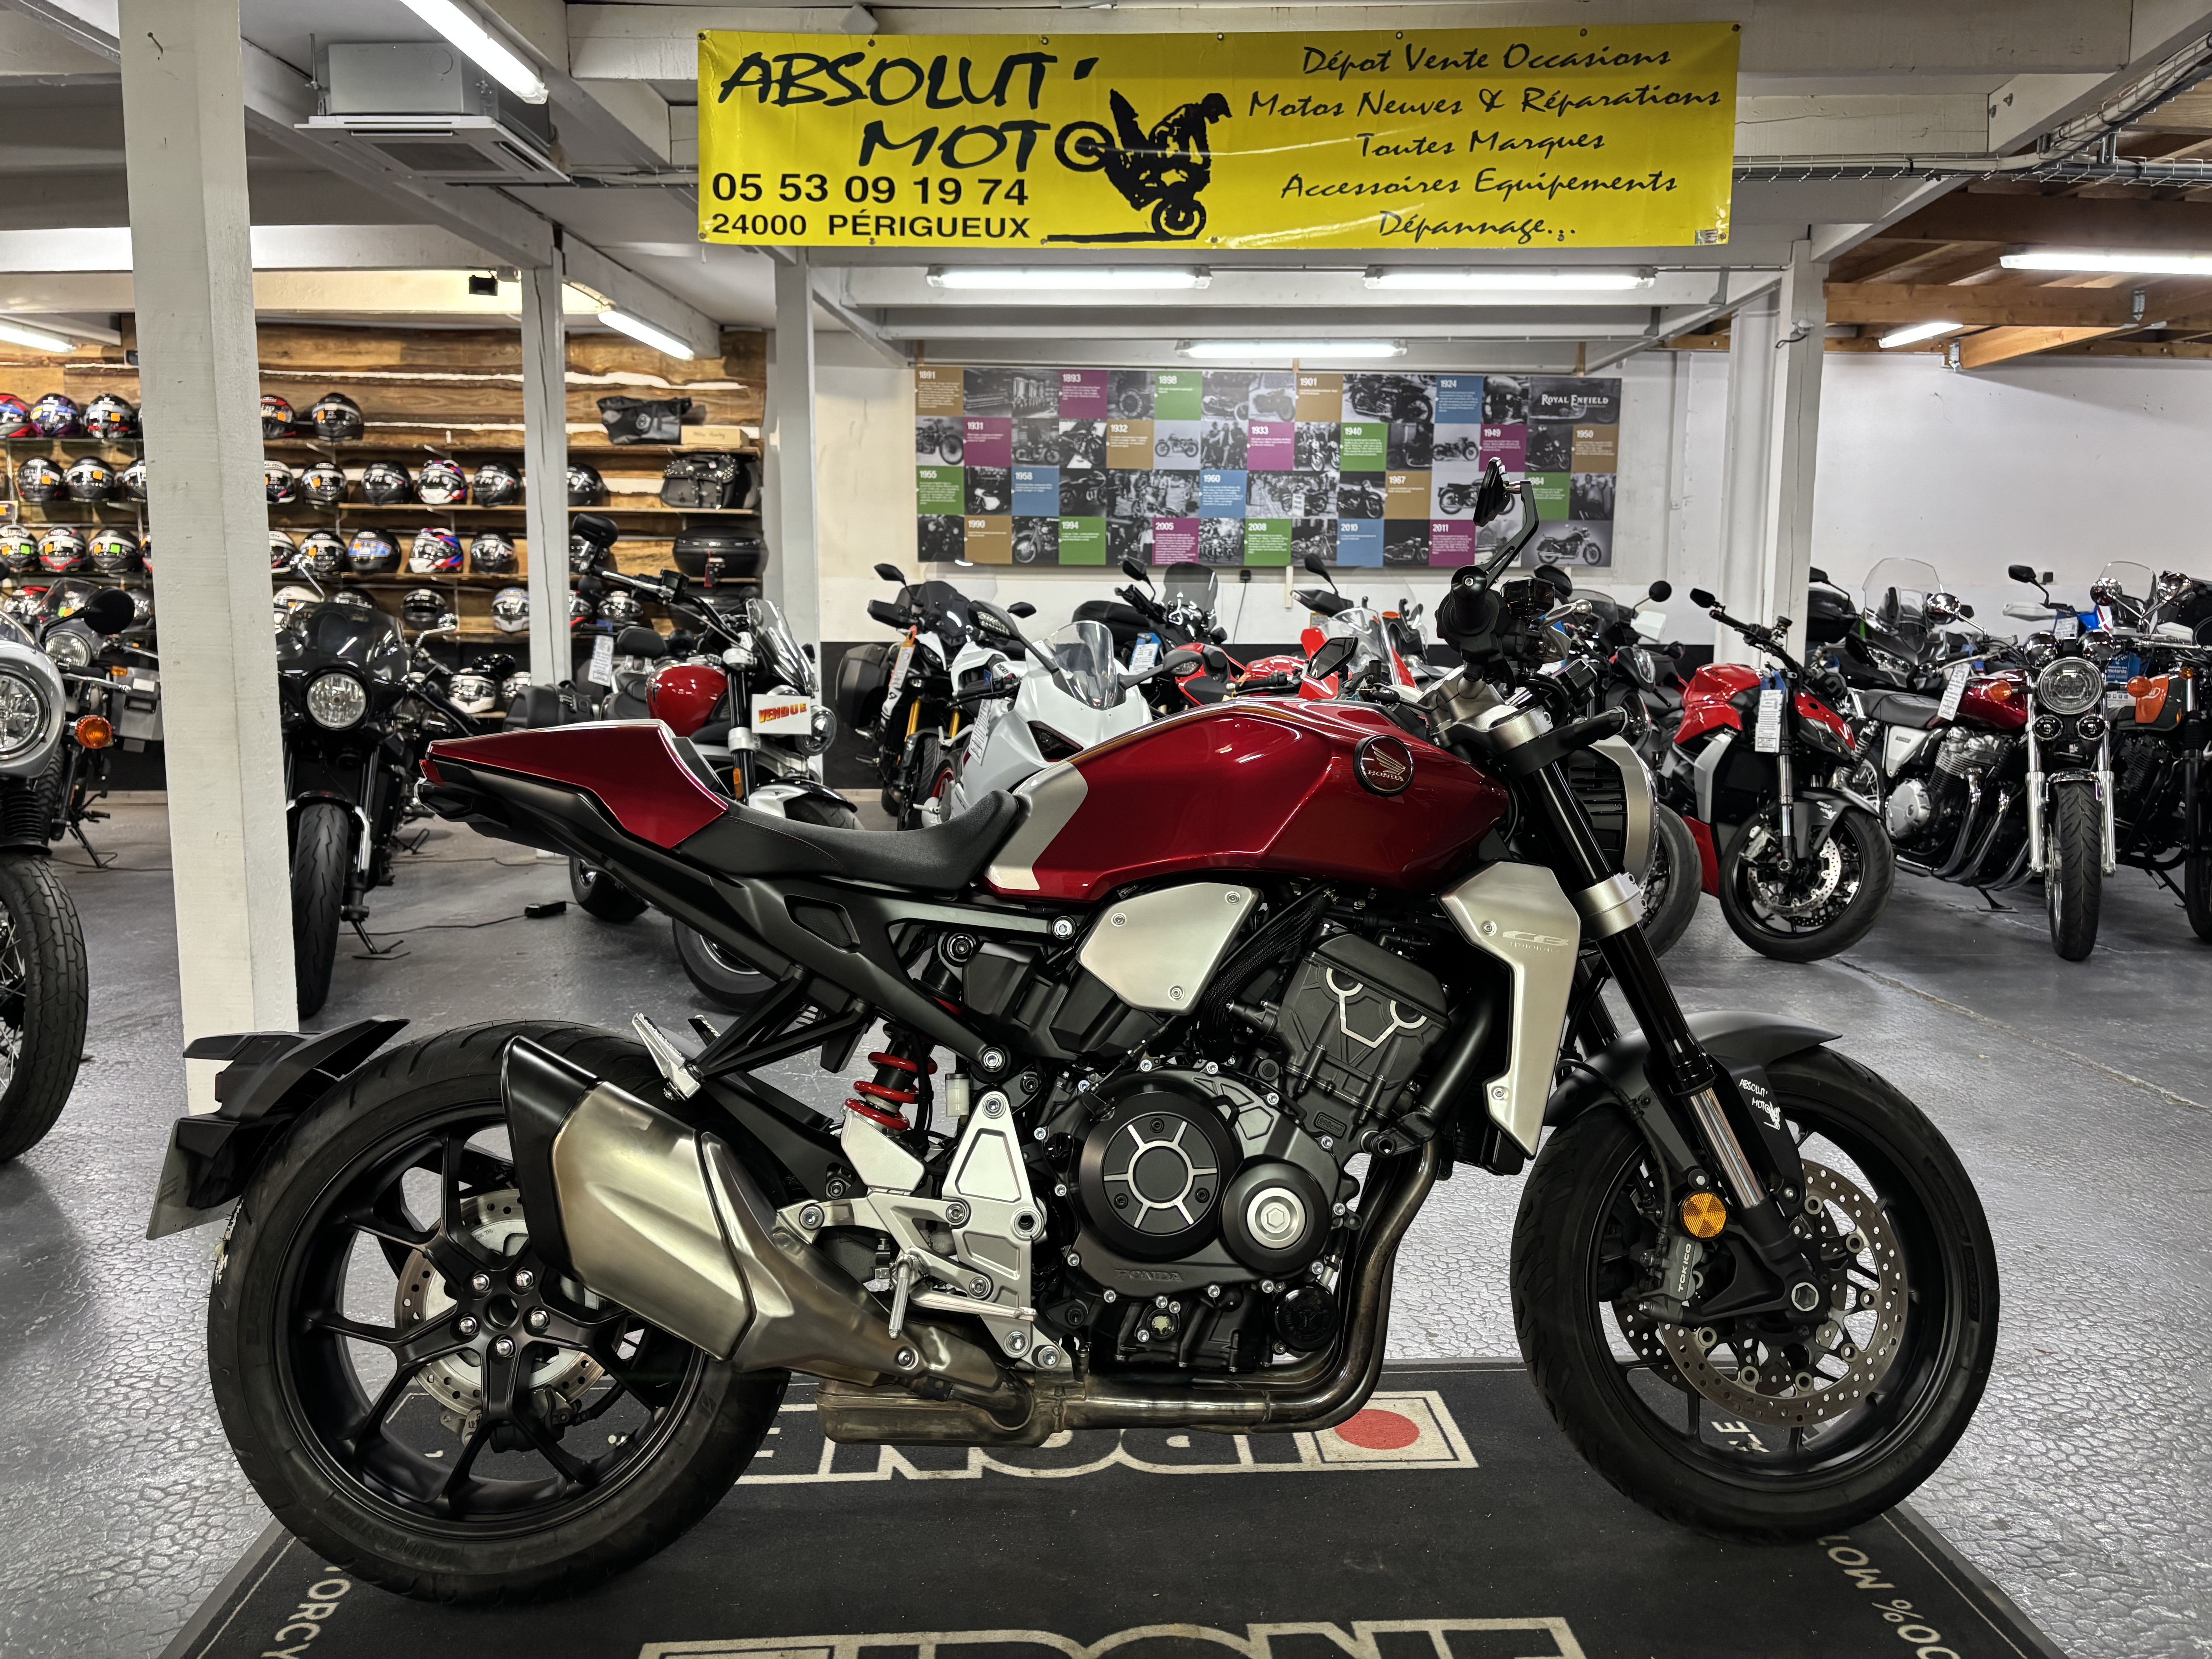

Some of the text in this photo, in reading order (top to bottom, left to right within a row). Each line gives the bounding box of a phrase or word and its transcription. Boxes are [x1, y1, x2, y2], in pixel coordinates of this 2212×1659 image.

[1303, 43, 1671, 75] Dépot Vente Occasions
[1249, 85, 1721, 117] Motos Neuves & Réparations
[1357, 130, 1604, 159] Toutes Marques
[713, 173, 1028, 205] 05 53 09 19 74
[1281, 168, 1677, 202] Accessoires Equipements
[713, 209, 1029, 238] 24000 PÉRIGUEUX
[1063, 374, 1081, 382] 1893
[1159, 376, 1177, 384] 1898
[1300, 378, 1317, 386] 1901
[1541, 394, 1608, 406] ROYAL ENFIELD
[1111, 424, 1128, 433] 1932
[1252, 426, 1268, 434] 1933
[1345, 427, 1362, 435] 1940
[1484, 429, 1501, 437] 1949
[759, 703, 807, 723] VENDUE
[1368, 769, 1404, 782] HONDA
[1678, 1243, 1691, 1293] TOKICO
[1115, 1269, 1184, 1282] HONDA
